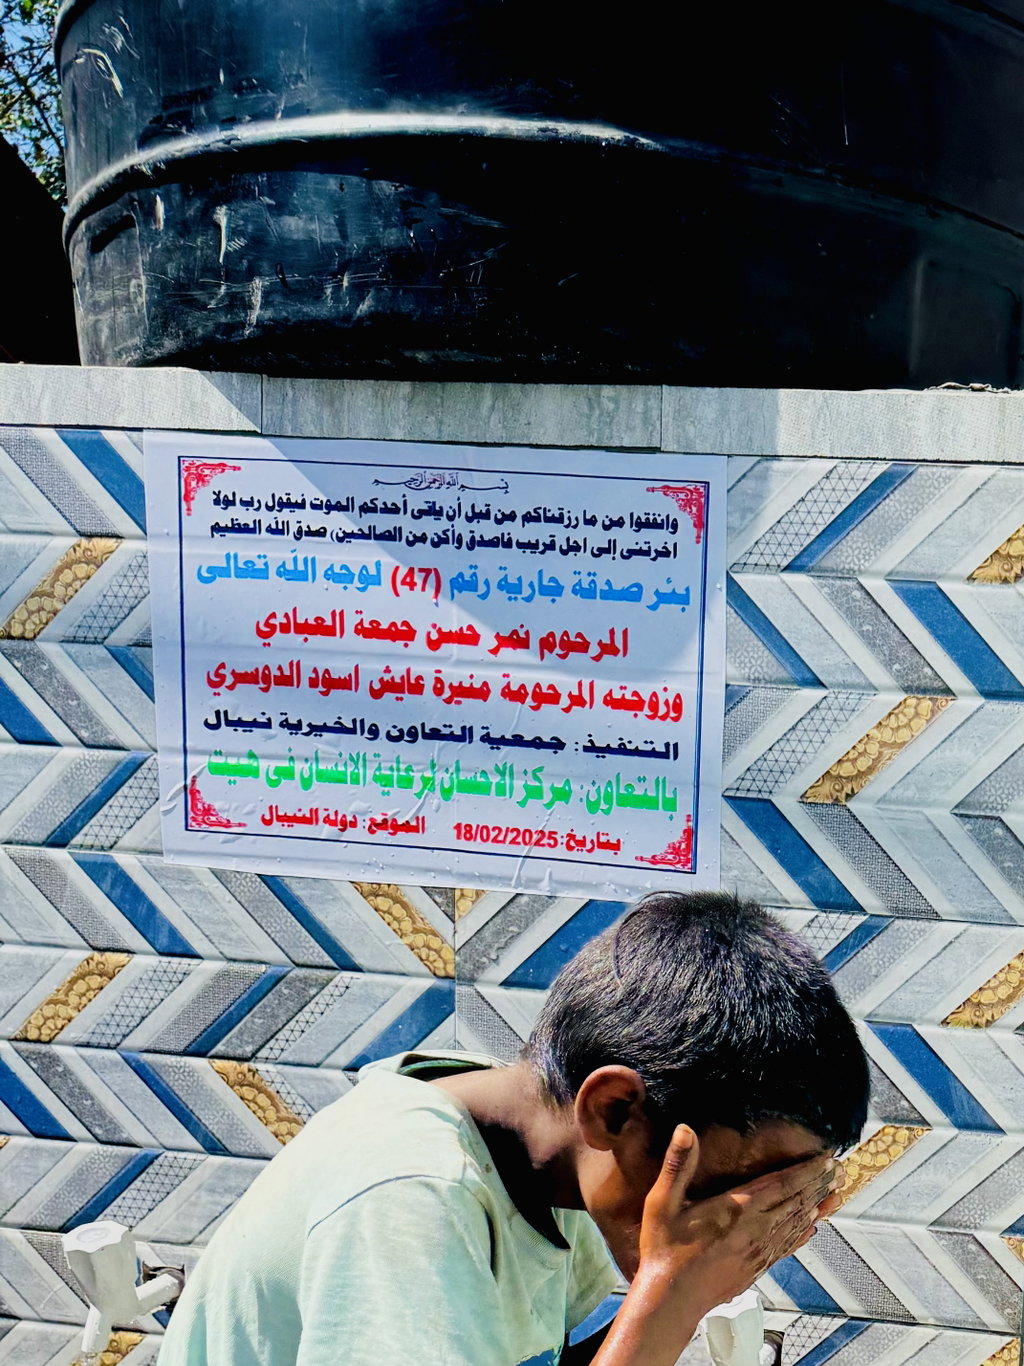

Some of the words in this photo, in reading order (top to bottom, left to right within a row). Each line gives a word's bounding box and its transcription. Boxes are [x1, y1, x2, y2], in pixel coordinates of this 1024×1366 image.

[212, 490, 236, 510] لولا
[239, 496, 262, 511] رب
[264, 492, 307, 513] فيقول
[309, 496, 355, 516] الموت
[358, 493, 408, 518] أحدكم
[446, 496, 462, 522] أن
[264, 516, 290, 536] الله
[464, 503, 491, 524] قبل
[493, 507, 518, 525] من
[521, 506, 580, 529] رزقناكم
[583, 509, 598, 528] ما
[601, 514, 626, 531] من
[629, 512, 679, 535] وانفقوا
[210, 517, 262, 539] العظيم
[292, 520, 328, 542] صدق
[405, 530, 429, 547] من
[430, 524, 464, 550] وأكن
[466, 529, 513, 551] فاصدق
[515, 534, 557, 555] قريب
[558, 535, 587, 557] اجل
[590, 538, 617, 561] إلى
[619, 540, 678, 562] اخرتنى
[196, 551, 270, 585] تعالى
[275, 548, 317, 584] الله
[323, 559, 382, 593] لوجه
[391, 564, 442, 601] (47)
[449, 563, 491, 602] رقم
[496, 565, 565, 604] جارية
[571, 569, 644, 603] صدقة
[646, 576, 691, 613] بئر
[255, 606, 345, 648] العبادي
[353, 609, 418, 648] جمعة
[425, 621, 481, 653] حسن
[487, 623, 530, 658] نمر
[538, 626, 629, 663] المرحوم
[206, 658, 301, 697] الدوسري
[307, 662, 360, 697] اسود
[368, 664, 425, 702] عايش
[432, 668, 492, 706] منيرة
[499, 672, 595, 714] المرحومة
[602, 685, 683, 723] وزوجته
[203, 709, 273, 733] نيبال
[278, 712, 380, 741] والخيرية
[385, 722, 474, 744] التعاون
[479, 725, 567, 755] جمعية
[574, 733, 679, 761] التنفيذ:
[299, 748, 368, 792] الانسان
[439, 758, 515, 802] الاحسان
[516, 764, 573, 810] مركز
[579, 772, 678, 821] بالتعاون:
[260, 804, 320, 828] النيبال
[322, 809, 358, 833] دولة
[361, 812, 426, 836] الموقع:
